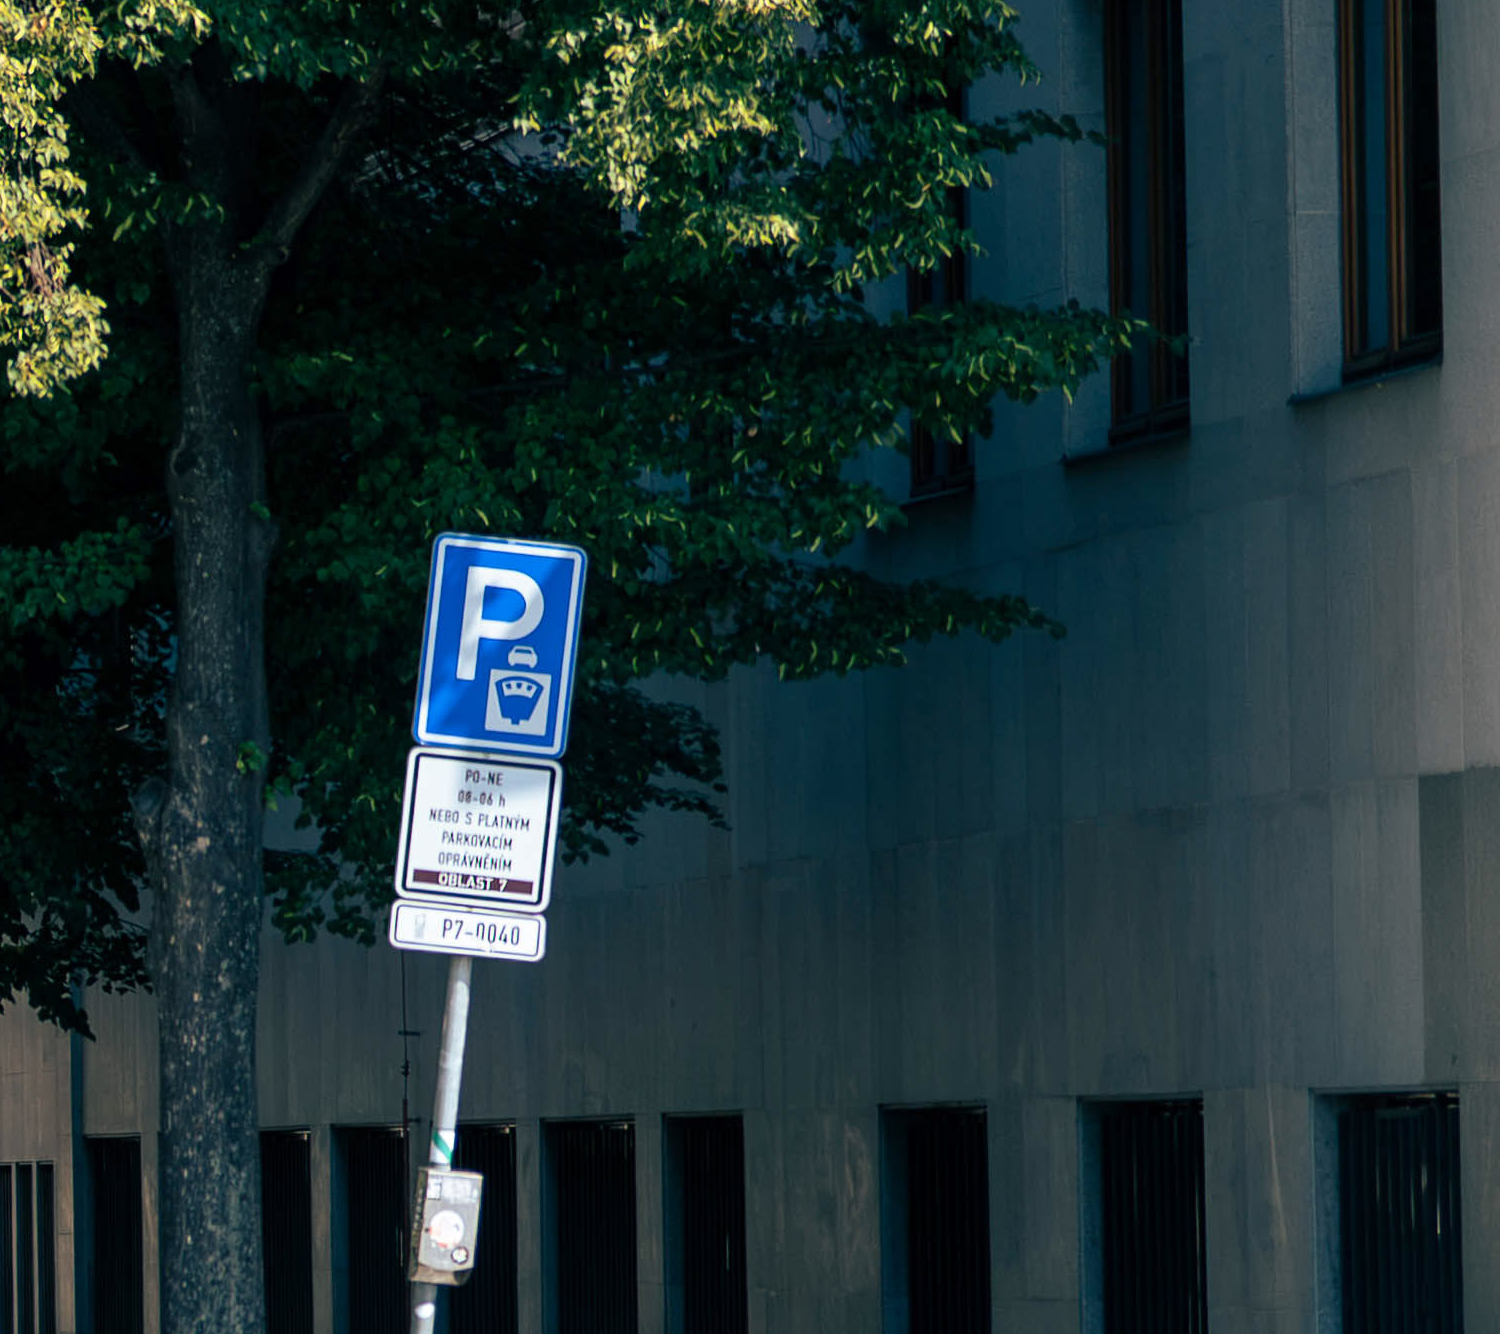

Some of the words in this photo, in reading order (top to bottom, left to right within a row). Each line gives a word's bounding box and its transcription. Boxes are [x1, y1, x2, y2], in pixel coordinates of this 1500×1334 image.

[456, 566, 545, 681] P
[465, 769, 504, 786] PO-NE
[457, 790, 493, 806] 08-06
[499, 793, 506, 806] h
[429, 808, 459, 824] NEBO
[465, 812, 473, 825] S
[478, 812, 530, 831] PLATNÝM
[441, 830, 513, 851] PARKOVACÍM
[438, 851, 512, 872] OPRÁVNĚNÍM
[438, 873, 494, 891] OBLAST
[498, 879, 508, 892] 7
[442, 919, 521, 946] P7-0040
